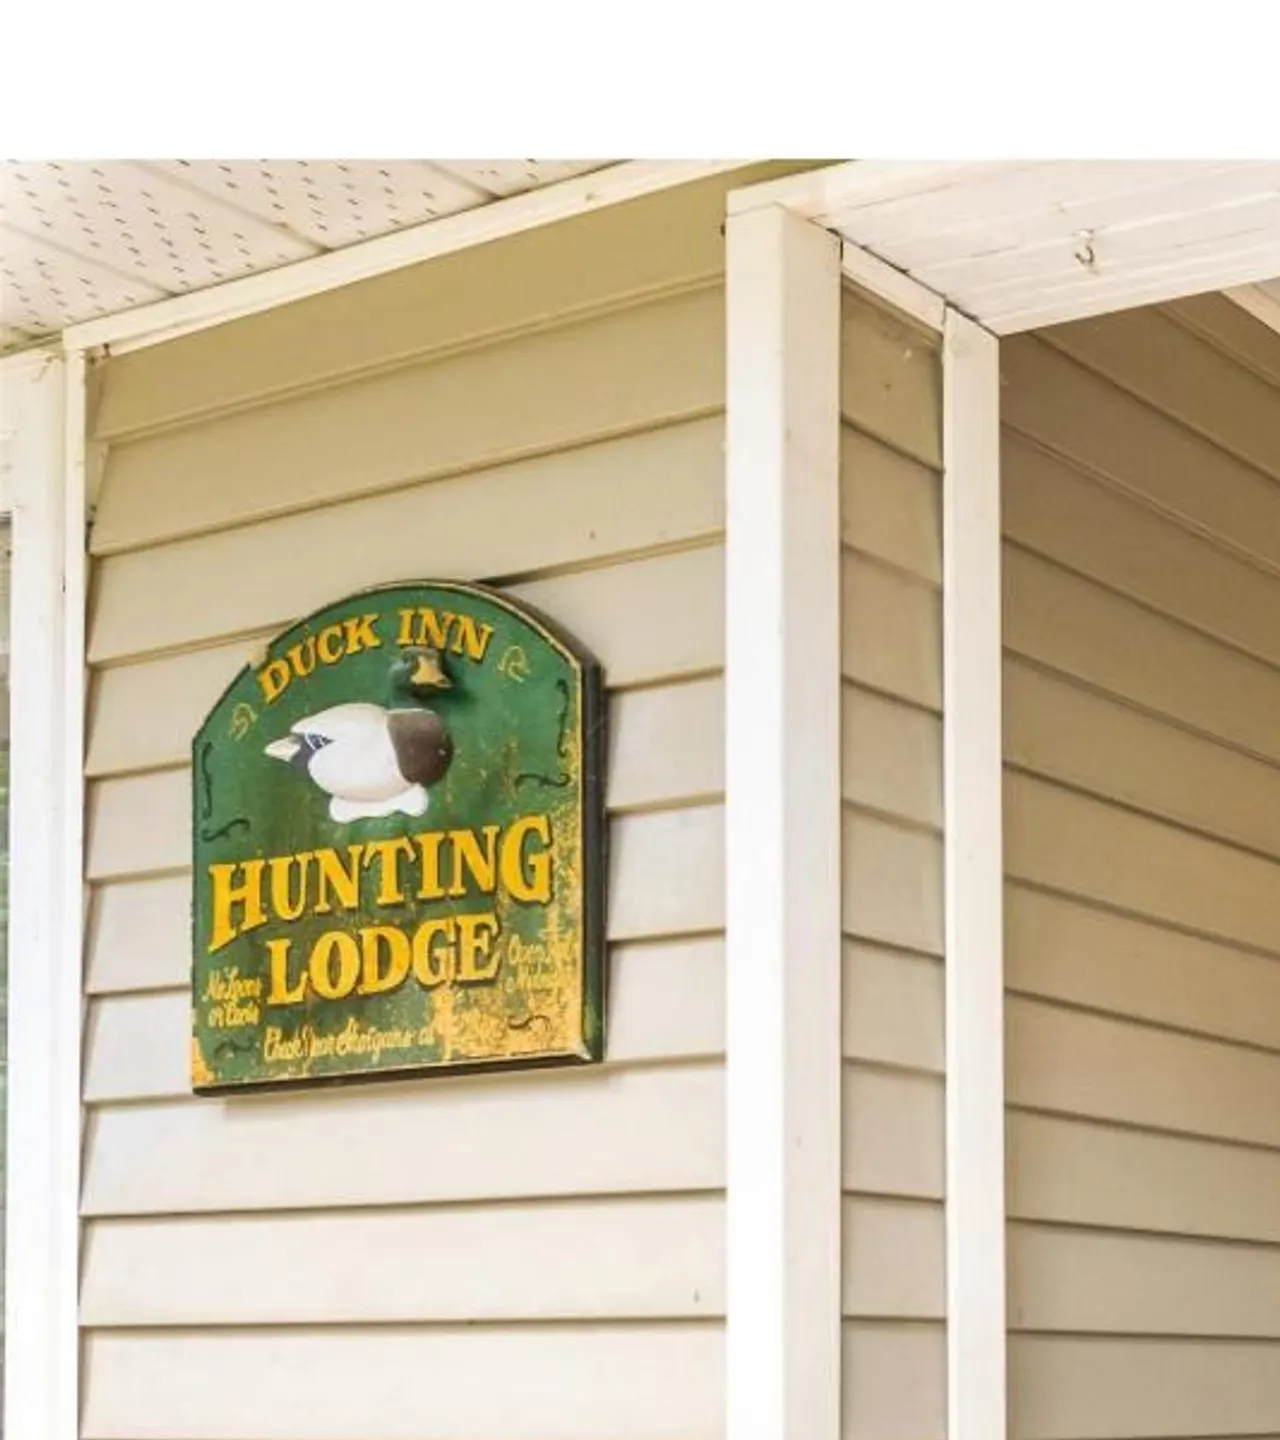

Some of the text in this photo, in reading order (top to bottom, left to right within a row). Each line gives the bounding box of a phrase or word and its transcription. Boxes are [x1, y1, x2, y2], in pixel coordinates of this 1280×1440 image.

[257, 606, 493, 704] DUCK INN
[208, 814, 554, 953] HUNTING
[266, 912, 501, 1007] LODGE
